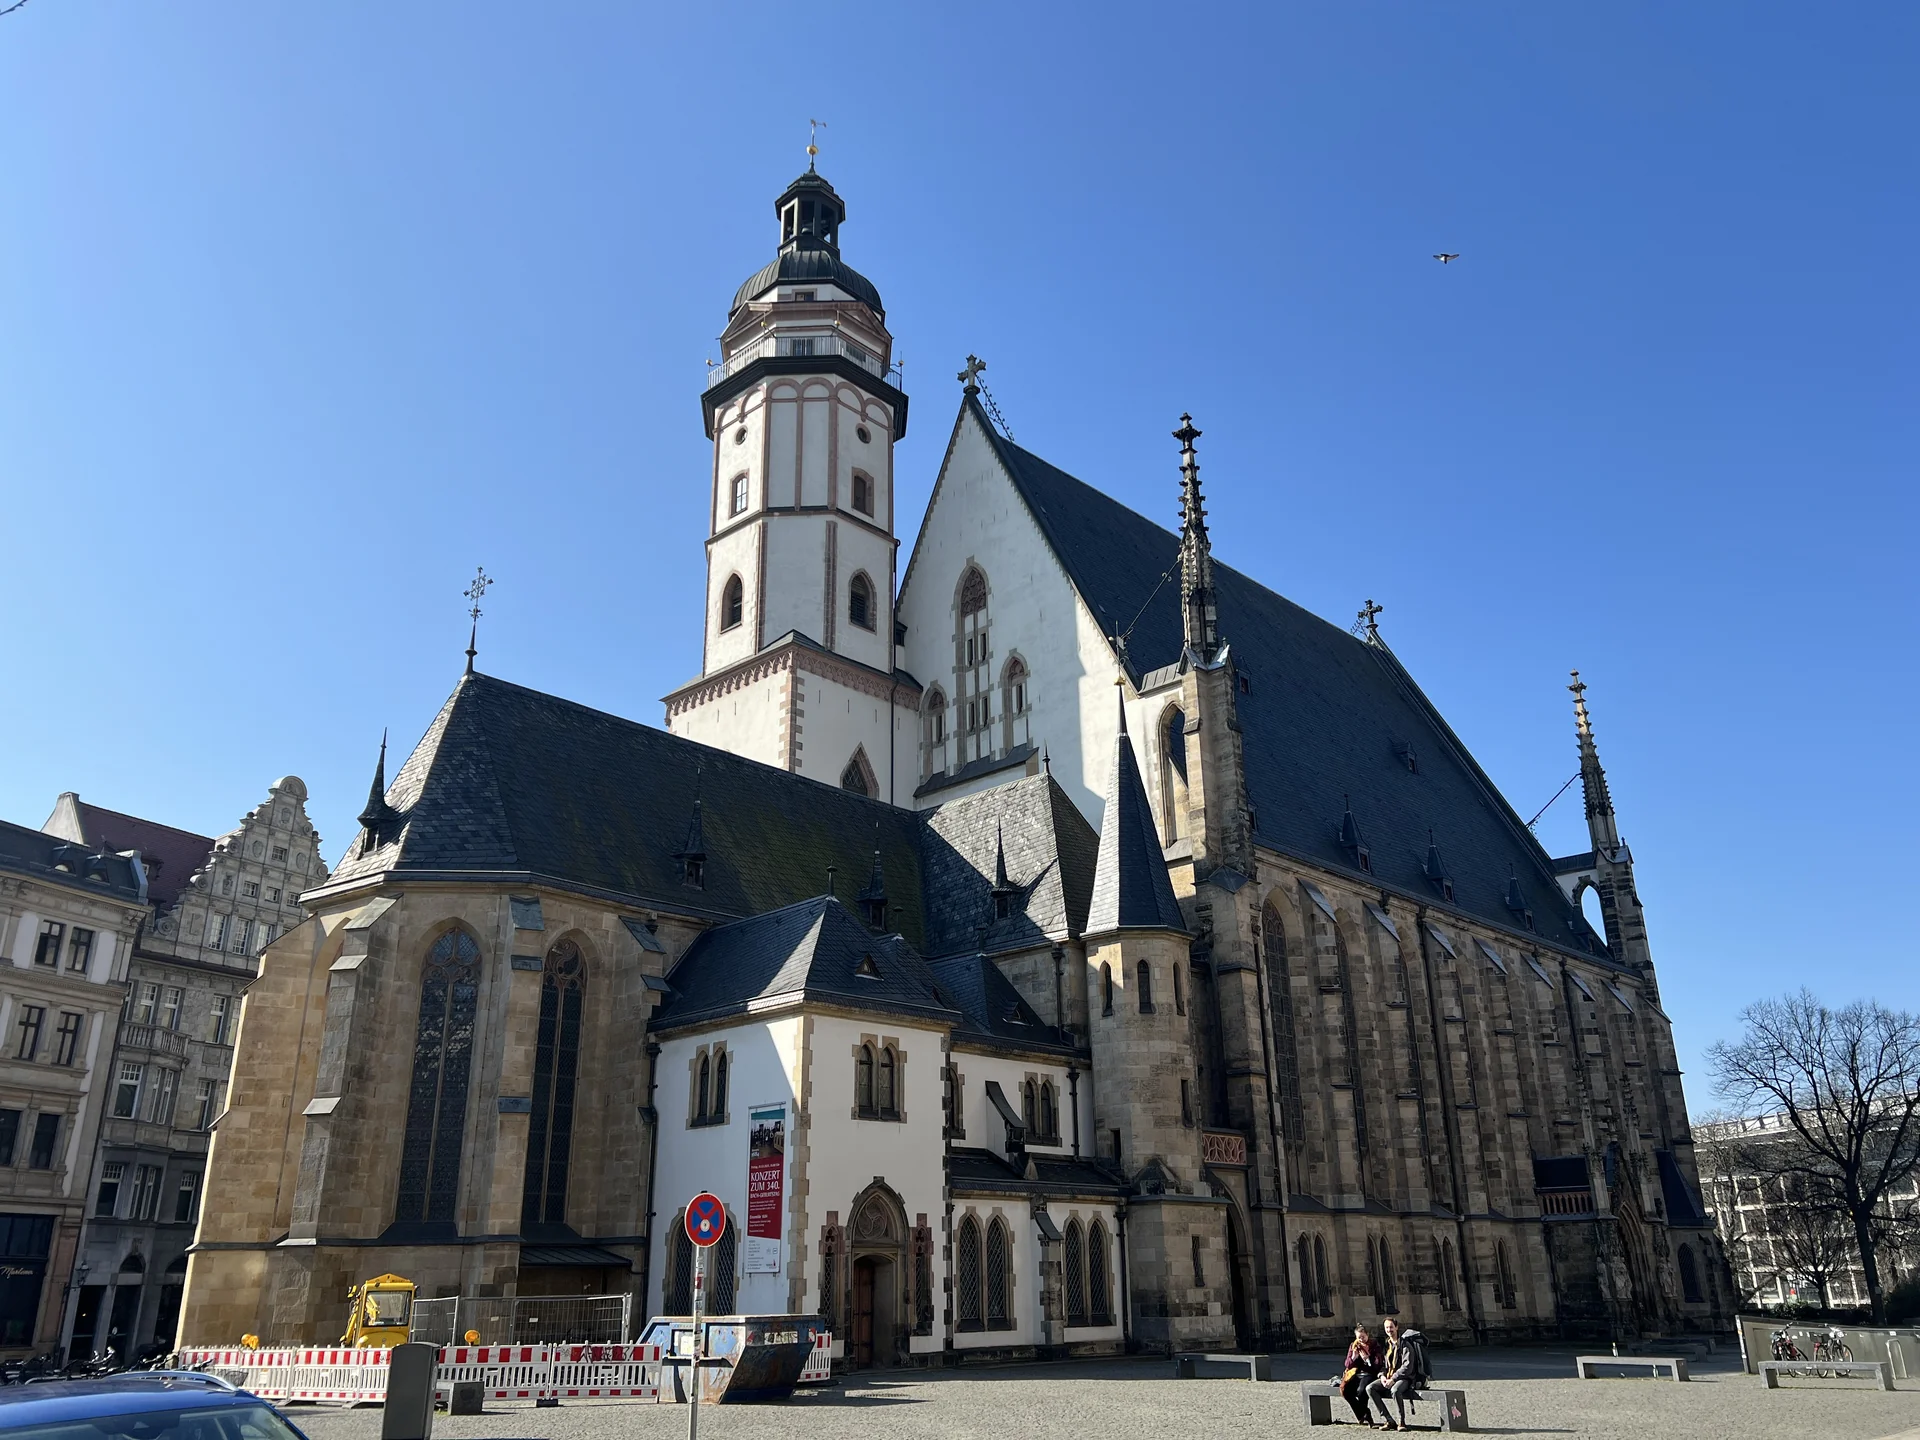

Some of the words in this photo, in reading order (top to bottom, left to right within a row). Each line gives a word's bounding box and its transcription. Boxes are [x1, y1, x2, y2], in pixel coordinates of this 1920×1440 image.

[750, 1170, 780, 1182] KONZERT
[750, 1182, 765, 1192] ZUM
[766, 1181, 780, 1190] 340.
